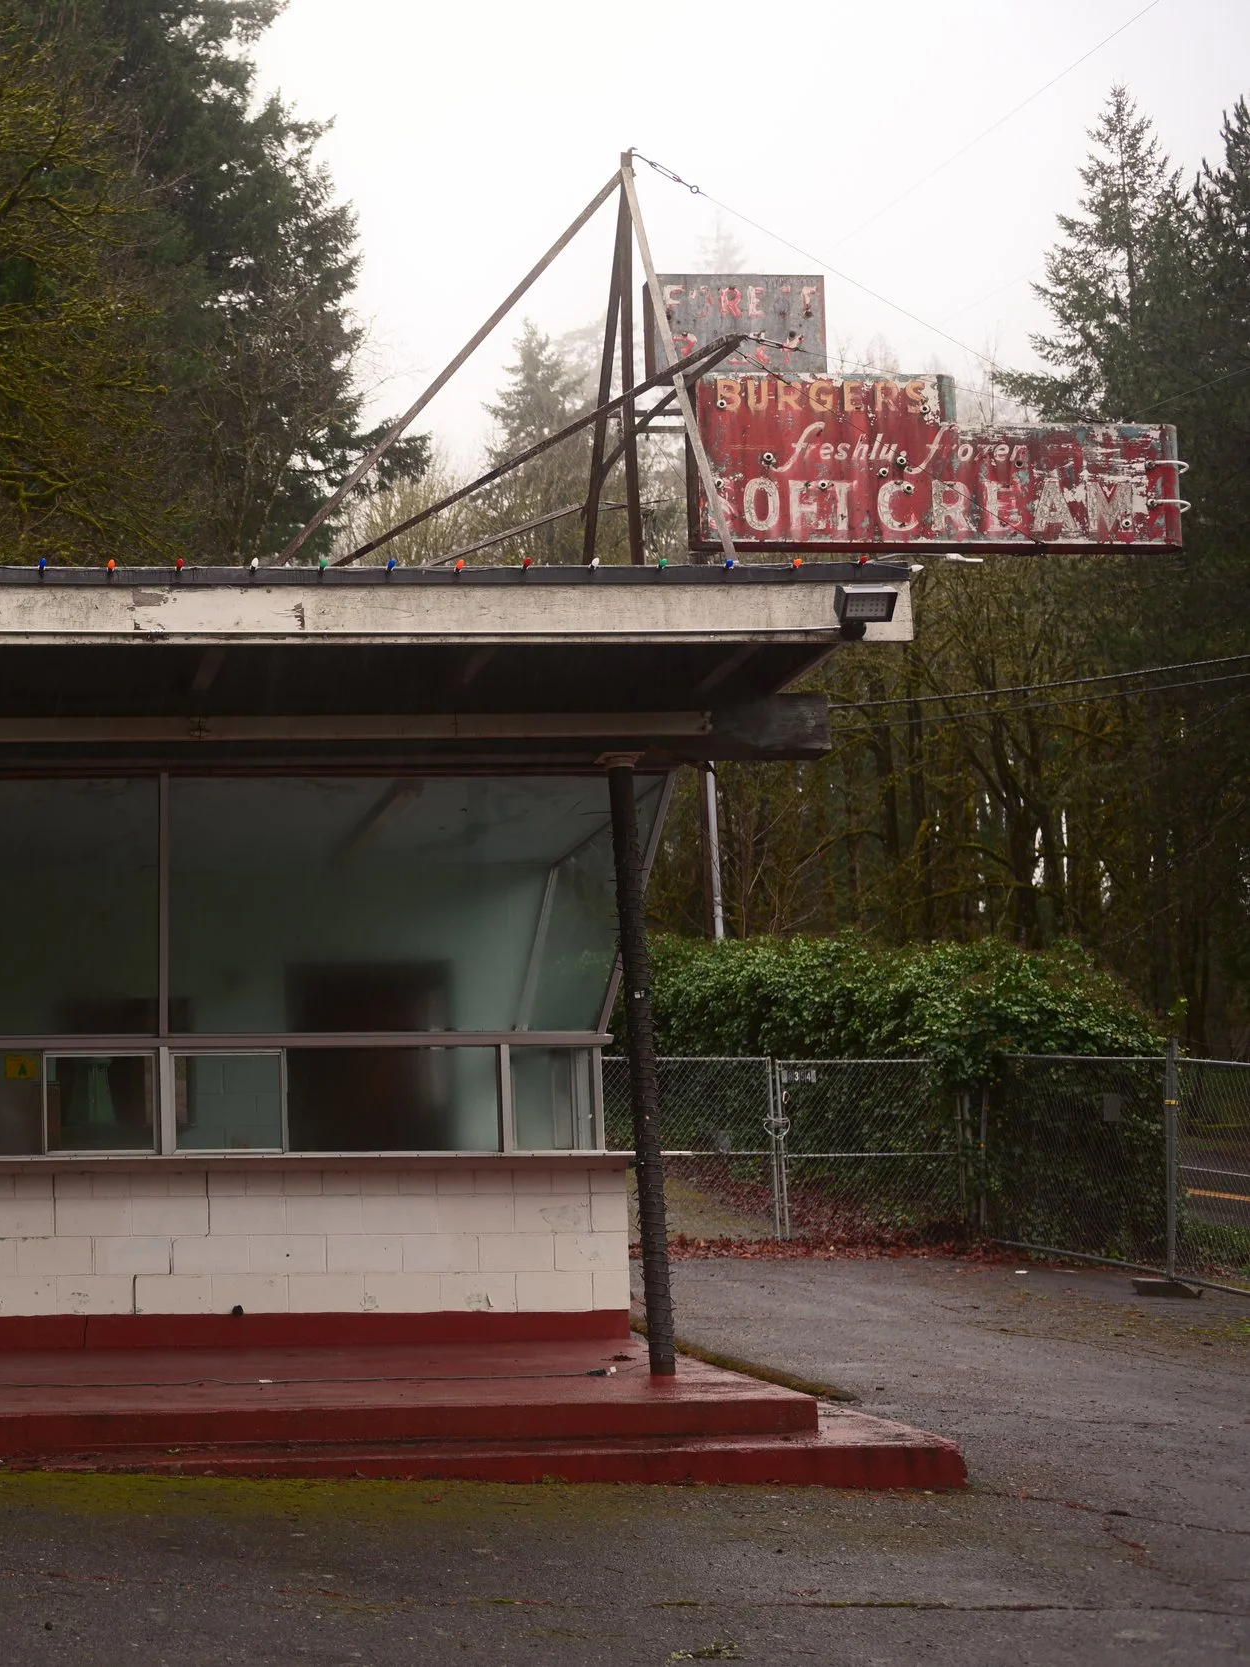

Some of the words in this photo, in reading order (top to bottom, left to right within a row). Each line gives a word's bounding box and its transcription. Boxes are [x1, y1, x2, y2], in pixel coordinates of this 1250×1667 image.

[663, 284, 817, 318] FORET
[716, 379, 926, 414] BURGERS
[904, 422, 1028, 475] fozen
[877, 479, 1134, 532] CREAM
